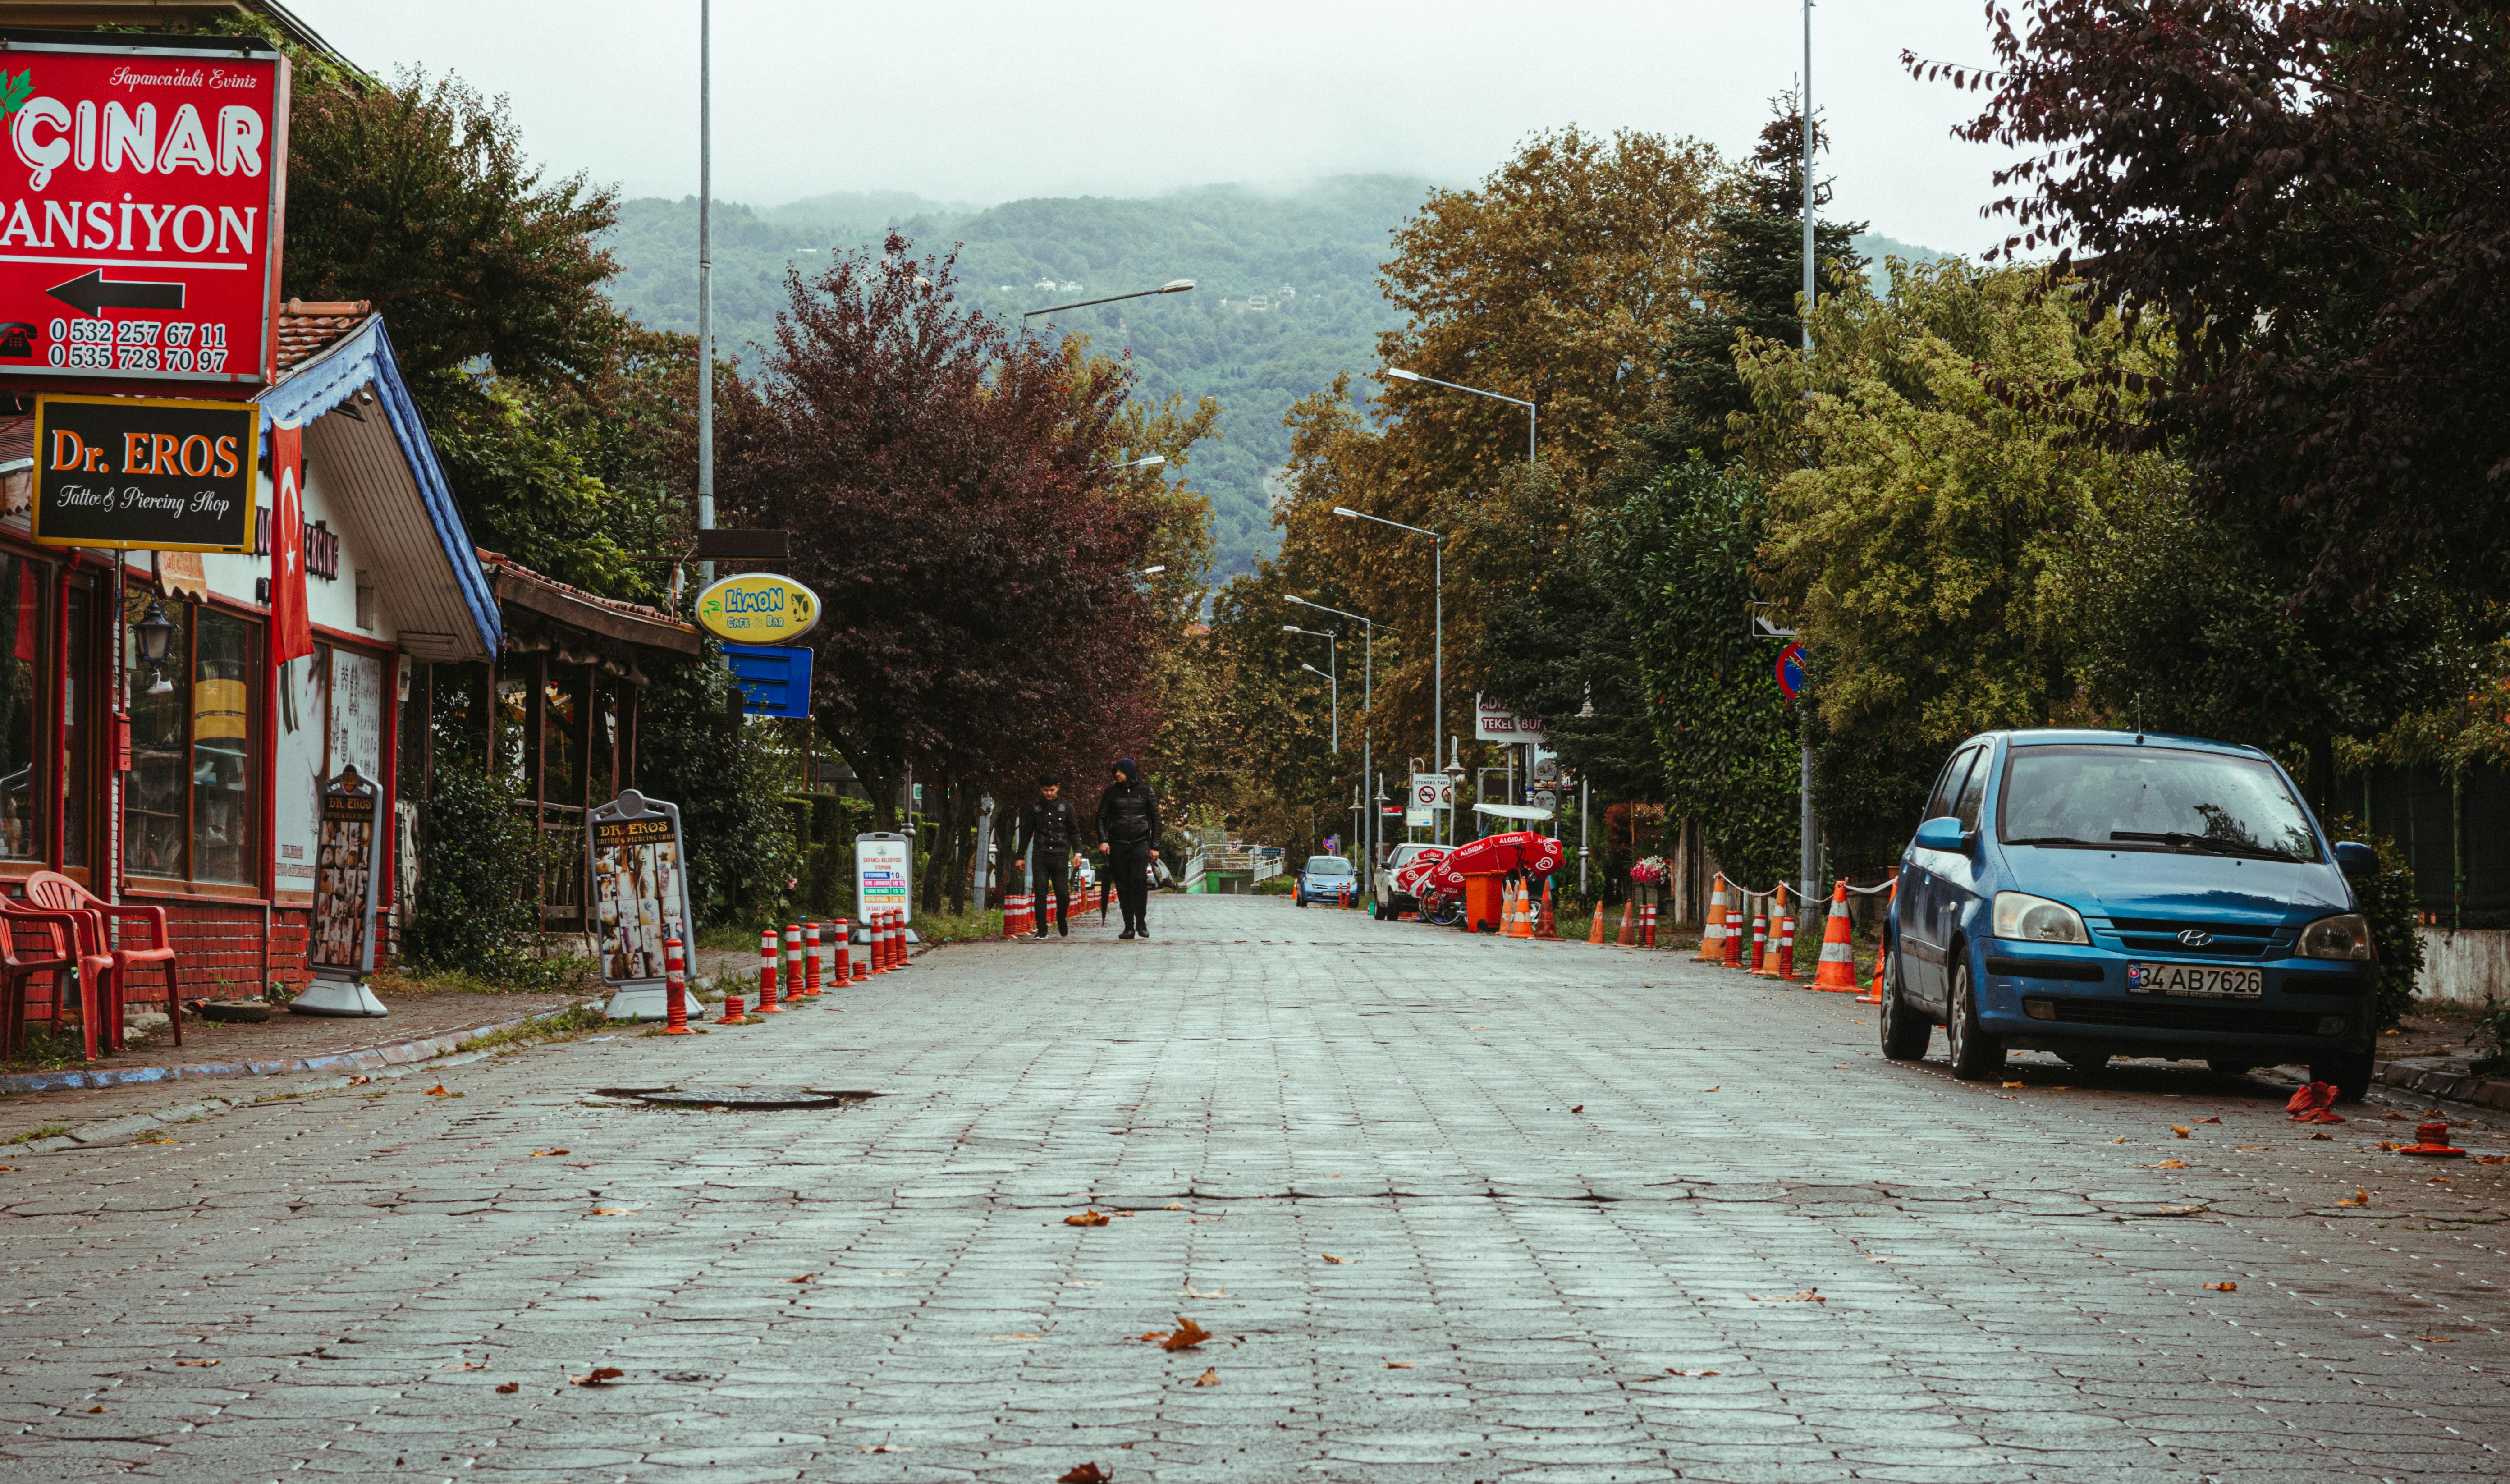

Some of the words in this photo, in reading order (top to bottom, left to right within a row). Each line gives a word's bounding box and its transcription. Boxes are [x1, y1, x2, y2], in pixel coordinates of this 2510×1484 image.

[110, 66, 203, 92] Sapanca'daki
[209, 68, 257, 89] Eviniz
[12, 96, 264, 191] ÇINAR
[0, 193, 257, 254] ANSİYON
[70, 319, 113, 343] 532
[117, 321, 160, 345] 257
[165, 323, 195, 346] 67
[201, 323, 226, 347] 11
[69, 345, 112, 369] 535
[118, 346, 160, 370] 728
[164, 348, 194, 371] 70
[197, 349, 227, 372] 97
[50, 430, 109, 473] Dr.
[122, 432, 238, 478] EROS
[57, 485, 101, 507] Tattoo
[103, 487, 114, 512] &
[120, 487, 184, 518] Piercing
[190, 491, 229, 520] Shop
[1482, 718, 1514, 730] TEKEL
[348, 798, 371, 809] EROS
[600, 825, 624, 836] DR.
[628, 822, 668, 834] EROS
